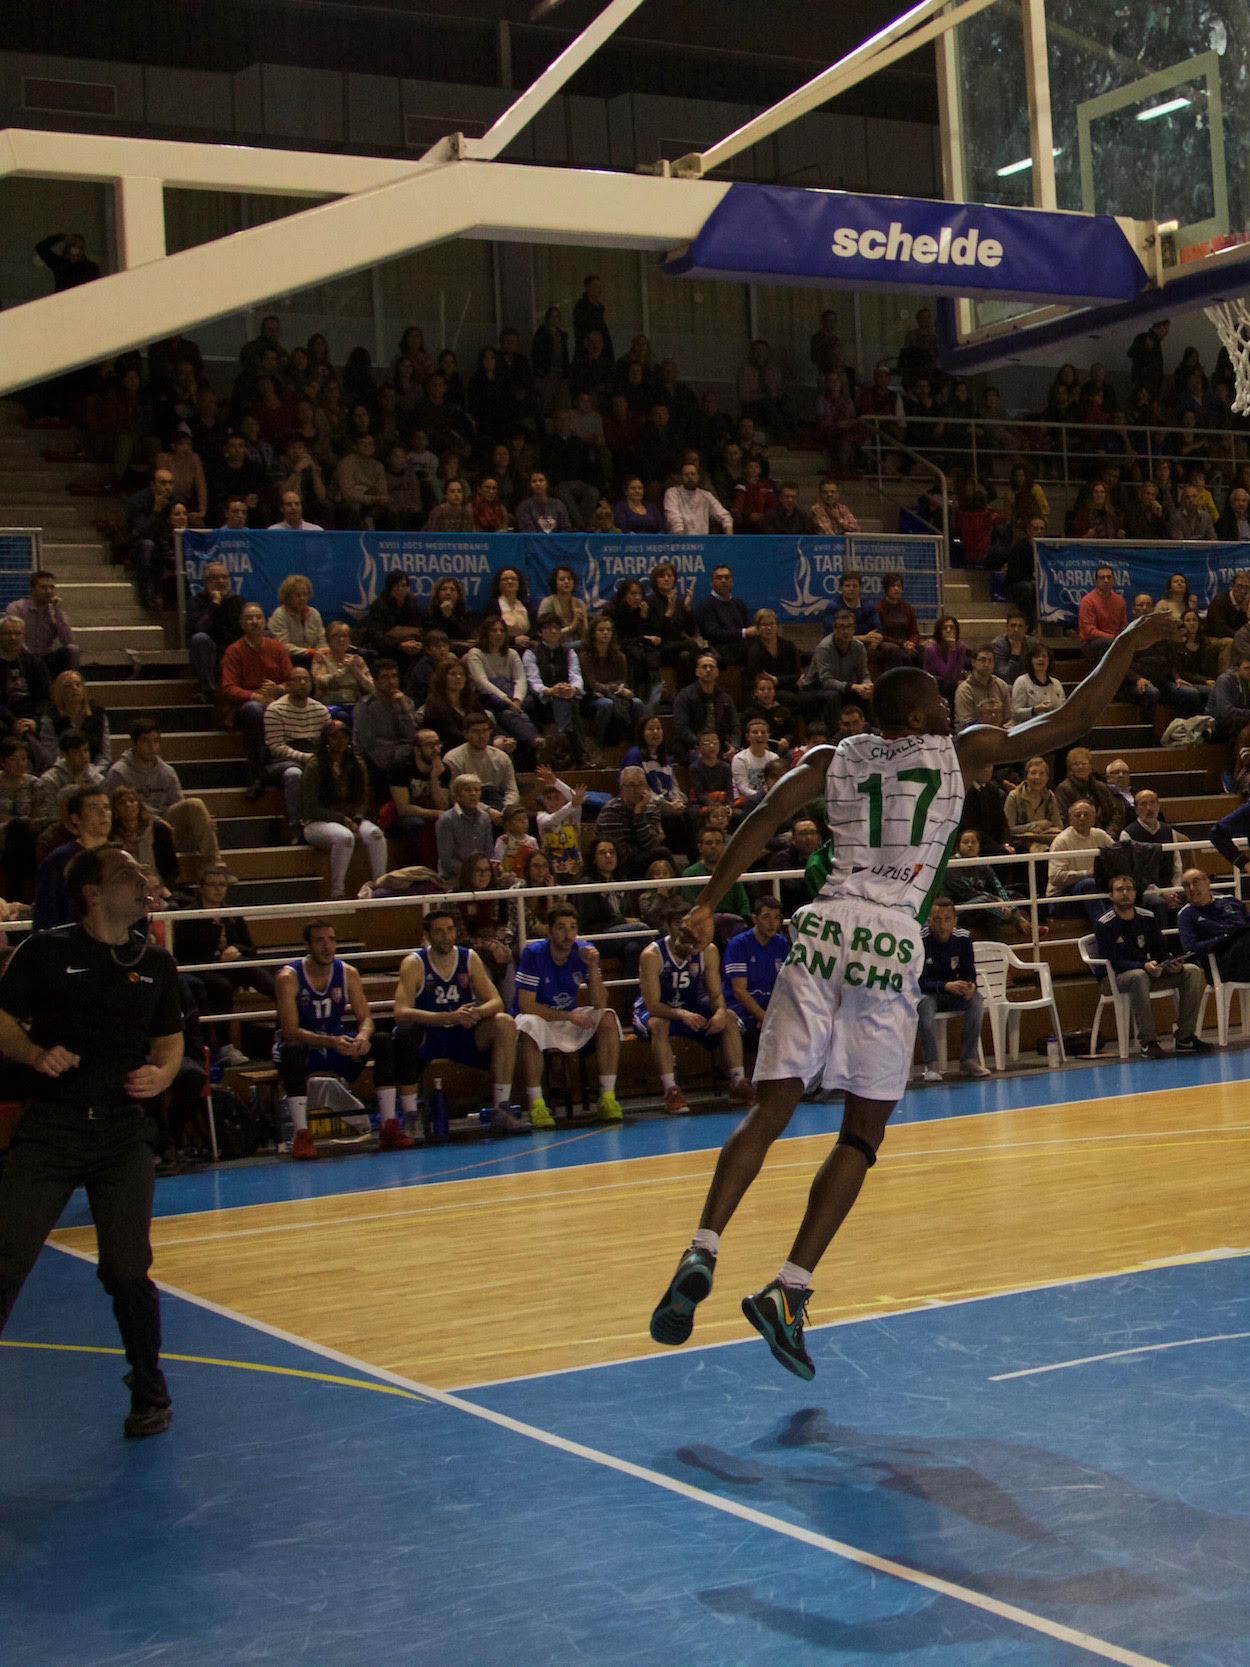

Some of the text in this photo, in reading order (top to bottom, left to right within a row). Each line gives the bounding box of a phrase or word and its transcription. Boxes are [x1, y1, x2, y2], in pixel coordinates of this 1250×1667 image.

[832, 222, 1004, 267] schelde
[378, 552, 491, 573] TARRAGONA
[813, 554, 906, 573] TARAGONA
[857, 767, 942, 848] 17
[850, 926, 914, 964] ROS
[671, 971, 690, 990] 15
[433, 983, 461, 1005] 24
[311, 997, 333, 1020] 11
